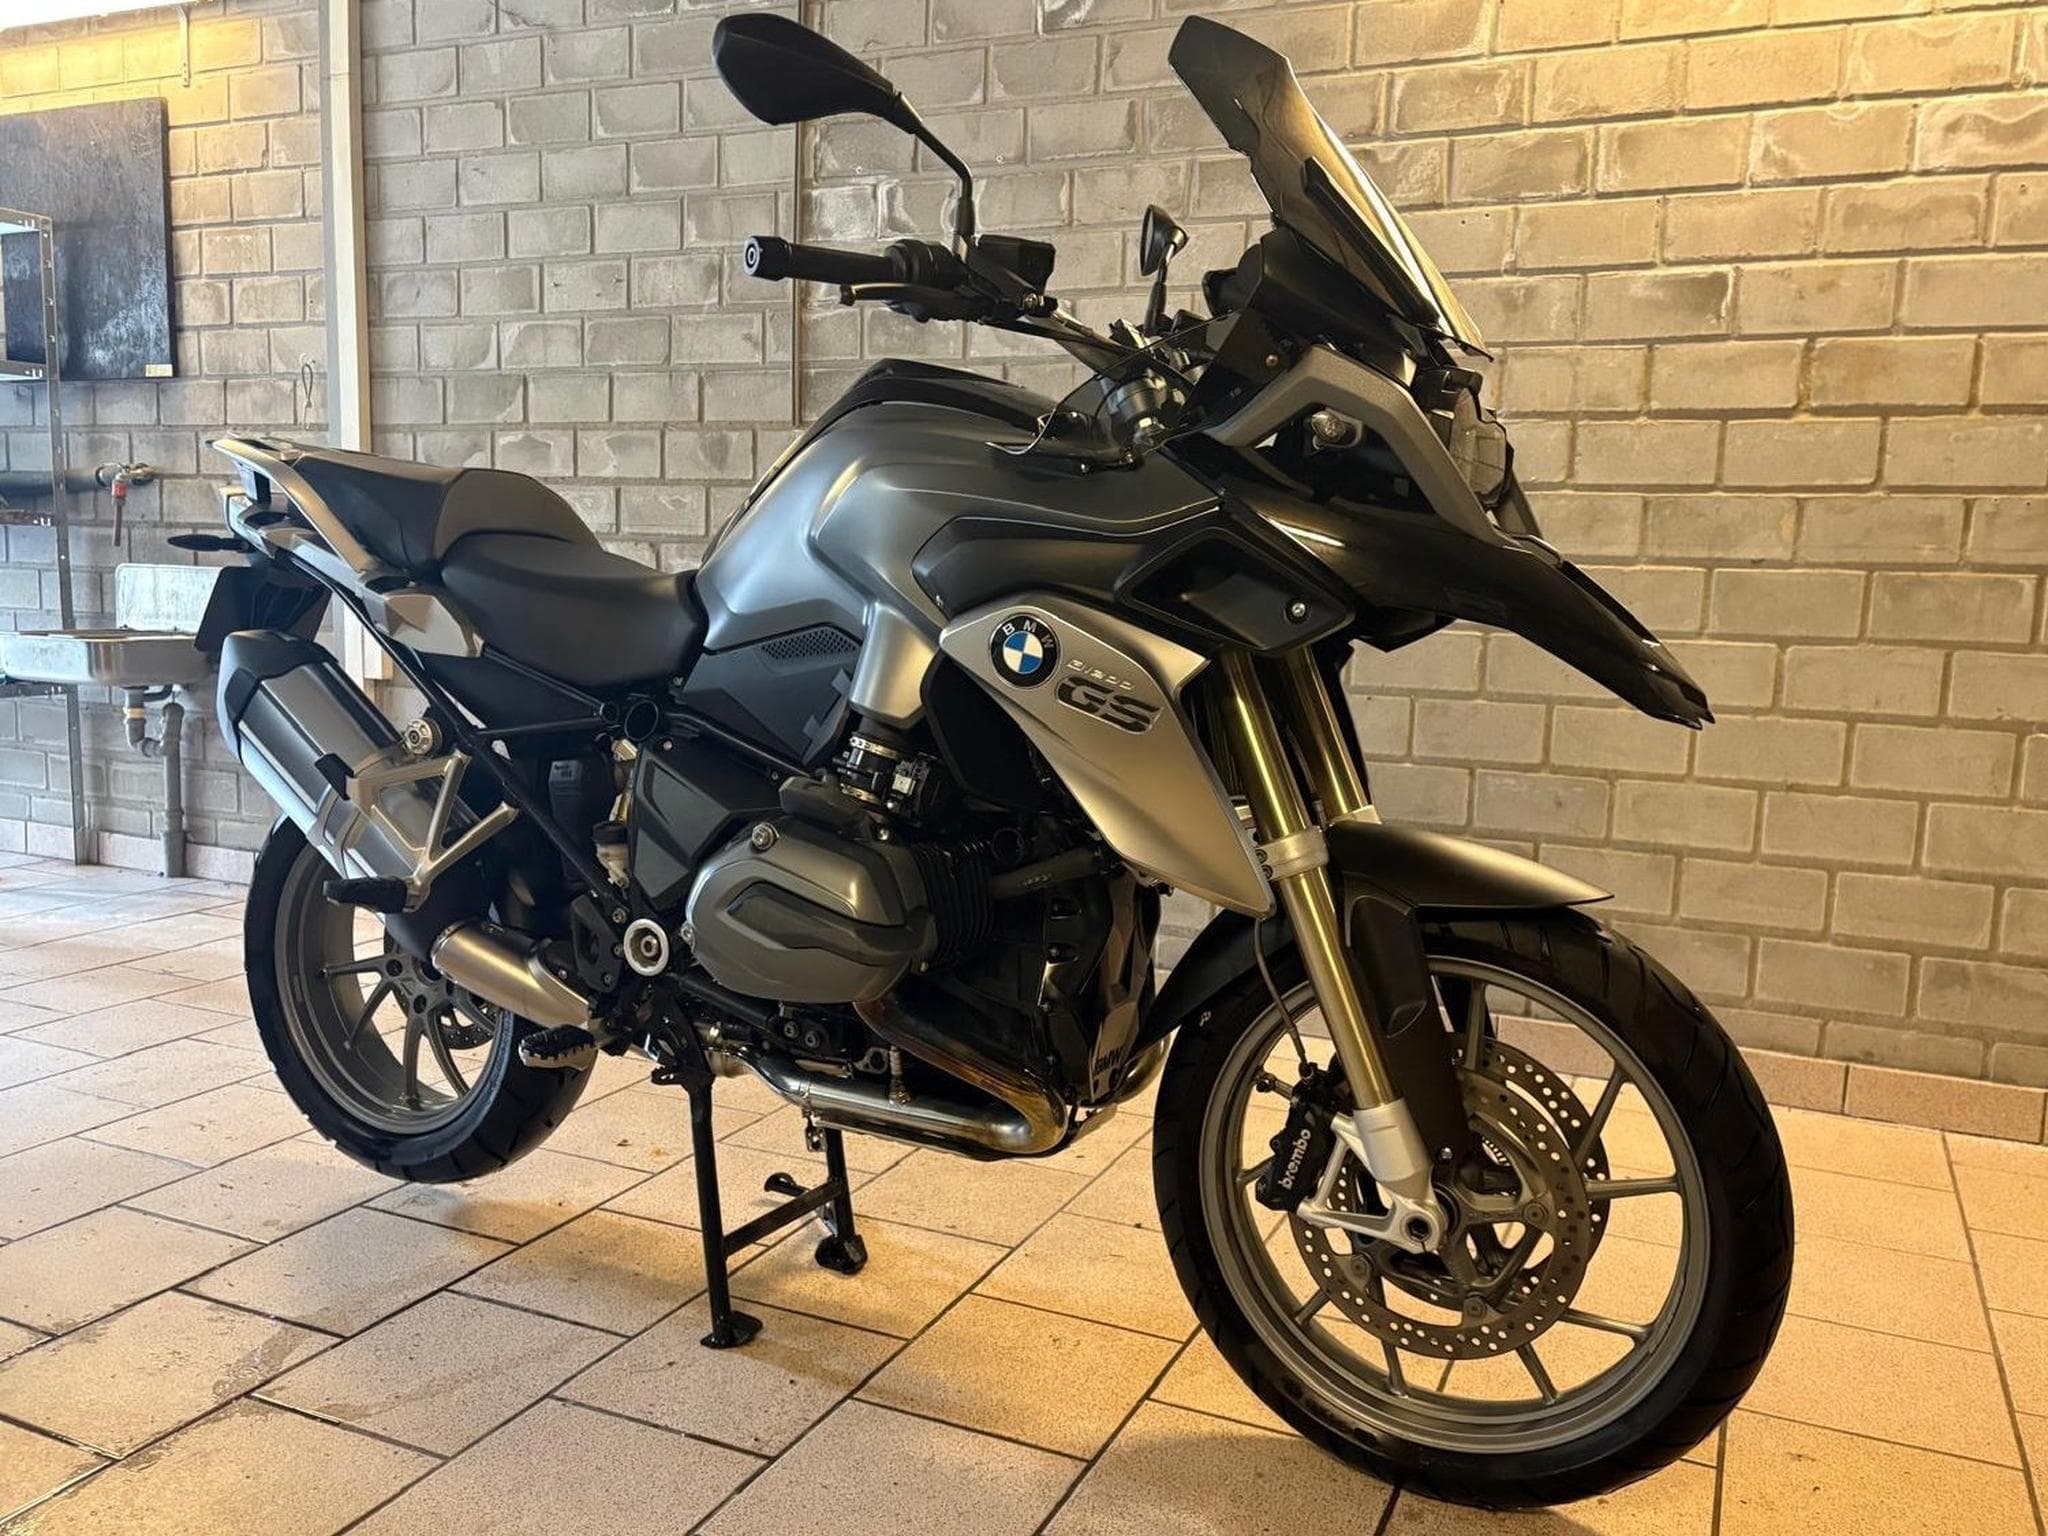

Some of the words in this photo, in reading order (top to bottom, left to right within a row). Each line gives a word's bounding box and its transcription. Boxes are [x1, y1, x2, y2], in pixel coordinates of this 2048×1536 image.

[1003, 619, 1055, 650] BMW
[1057, 676, 1161, 733] GS
[1278, 1128, 1312, 1190] brembo
